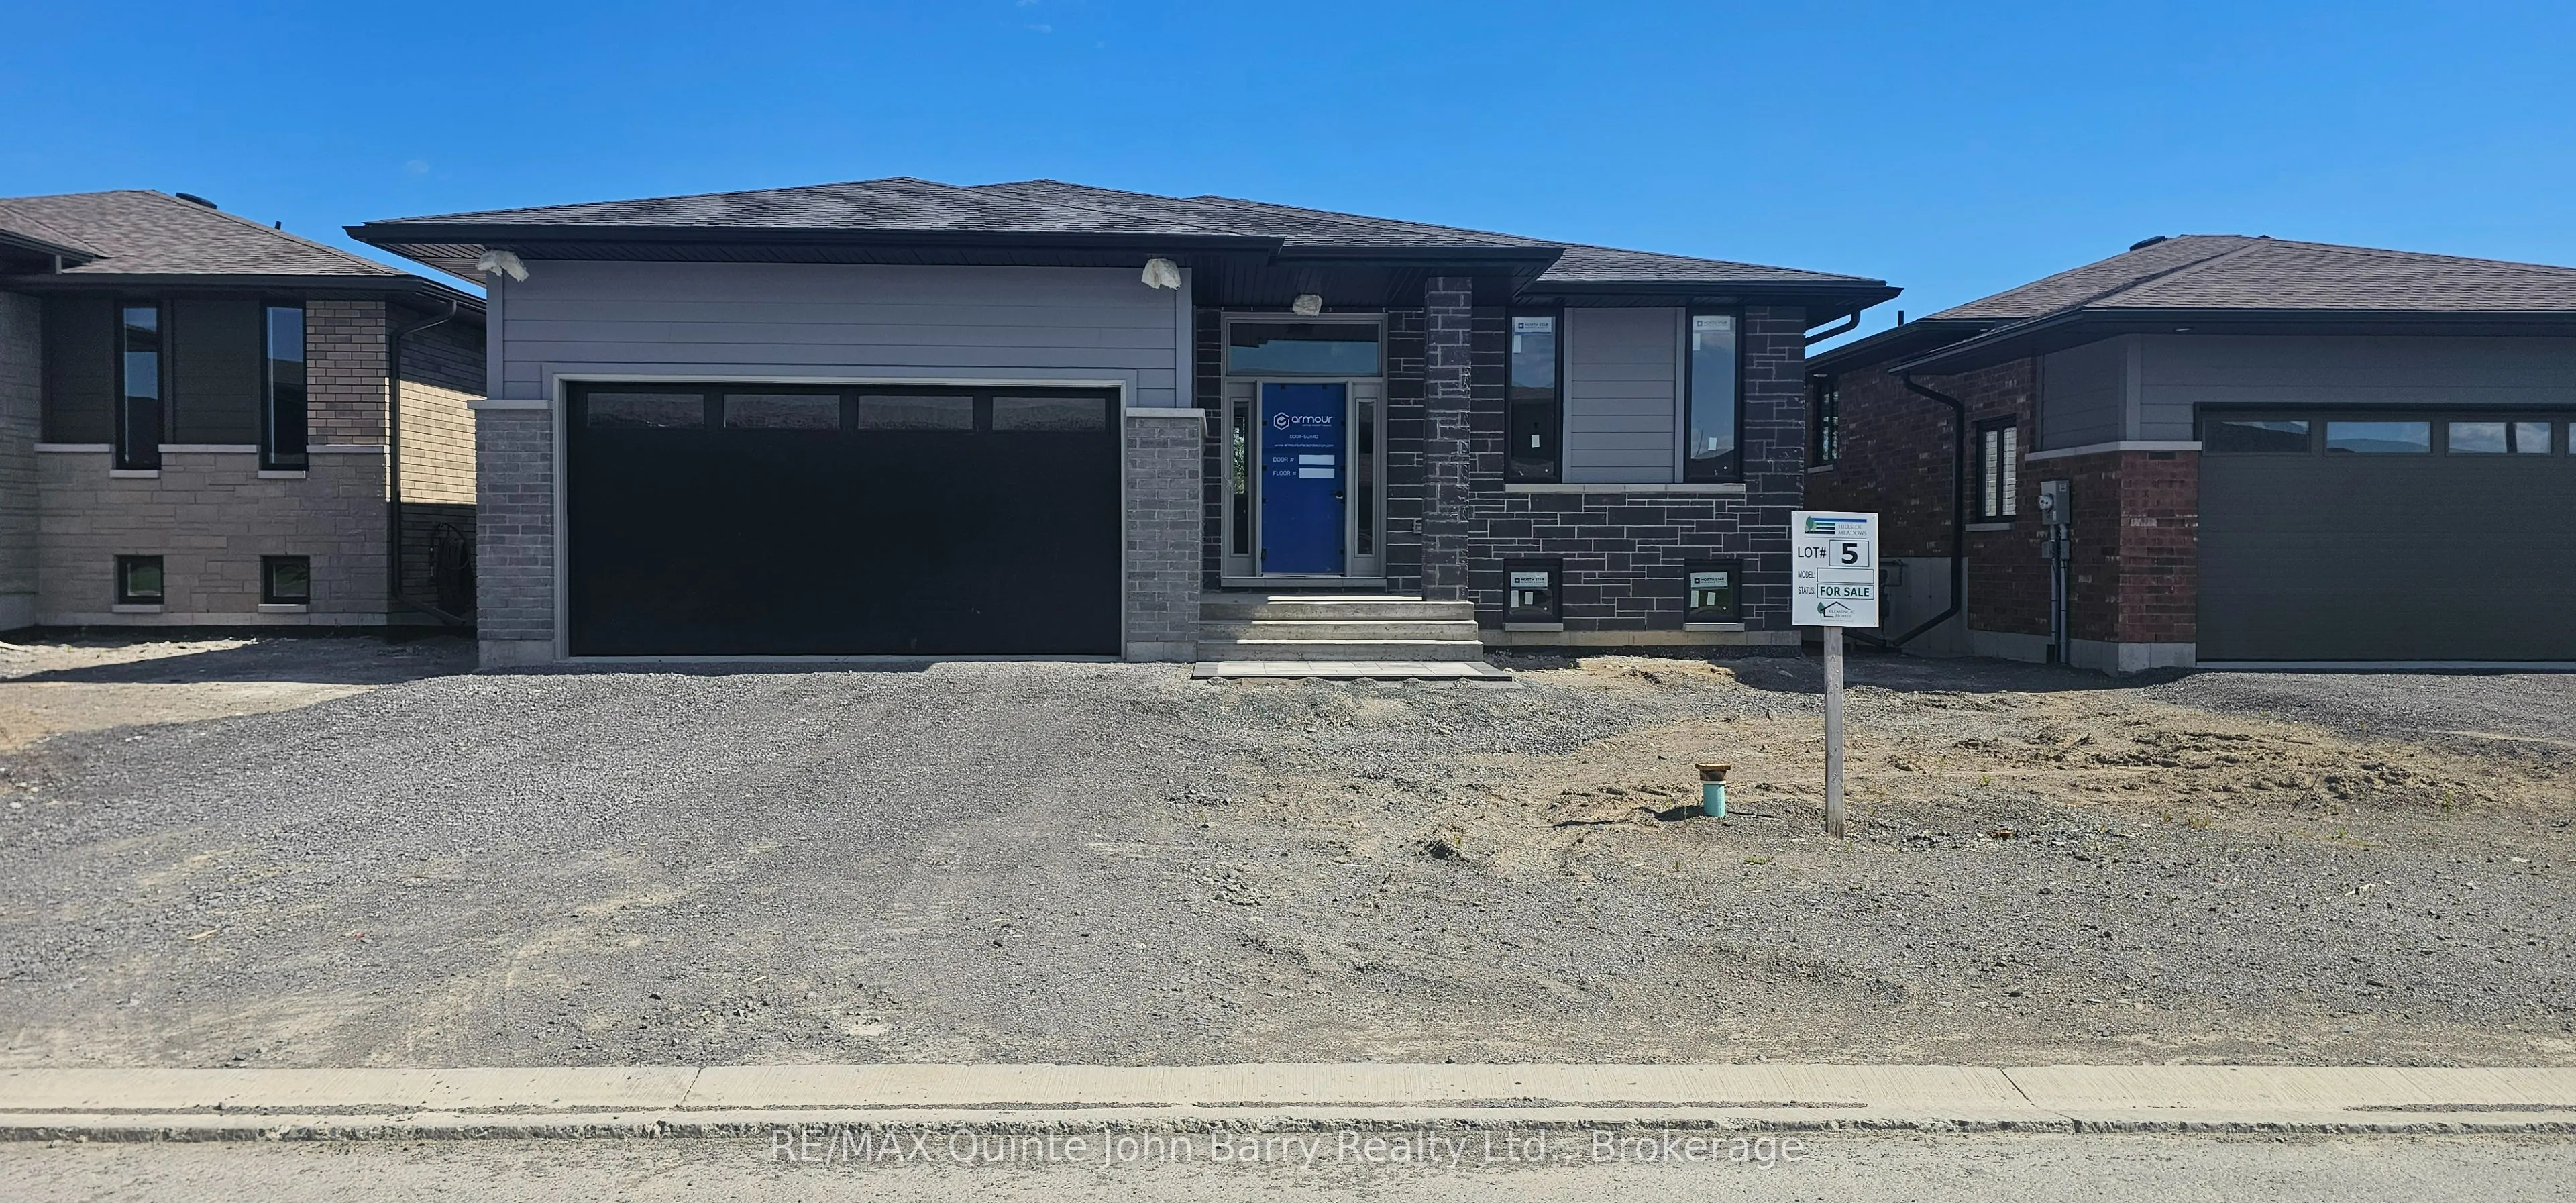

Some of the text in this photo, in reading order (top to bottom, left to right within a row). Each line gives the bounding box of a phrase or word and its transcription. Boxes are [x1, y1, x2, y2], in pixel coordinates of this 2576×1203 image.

[1291, 415, 1332, 423] armour
[1797, 543, 1858, 564] LOT# 5
[1798, 570, 1815, 578] MODEL:
[1798, 586, 1870, 597] STATUS: FOR SALE
